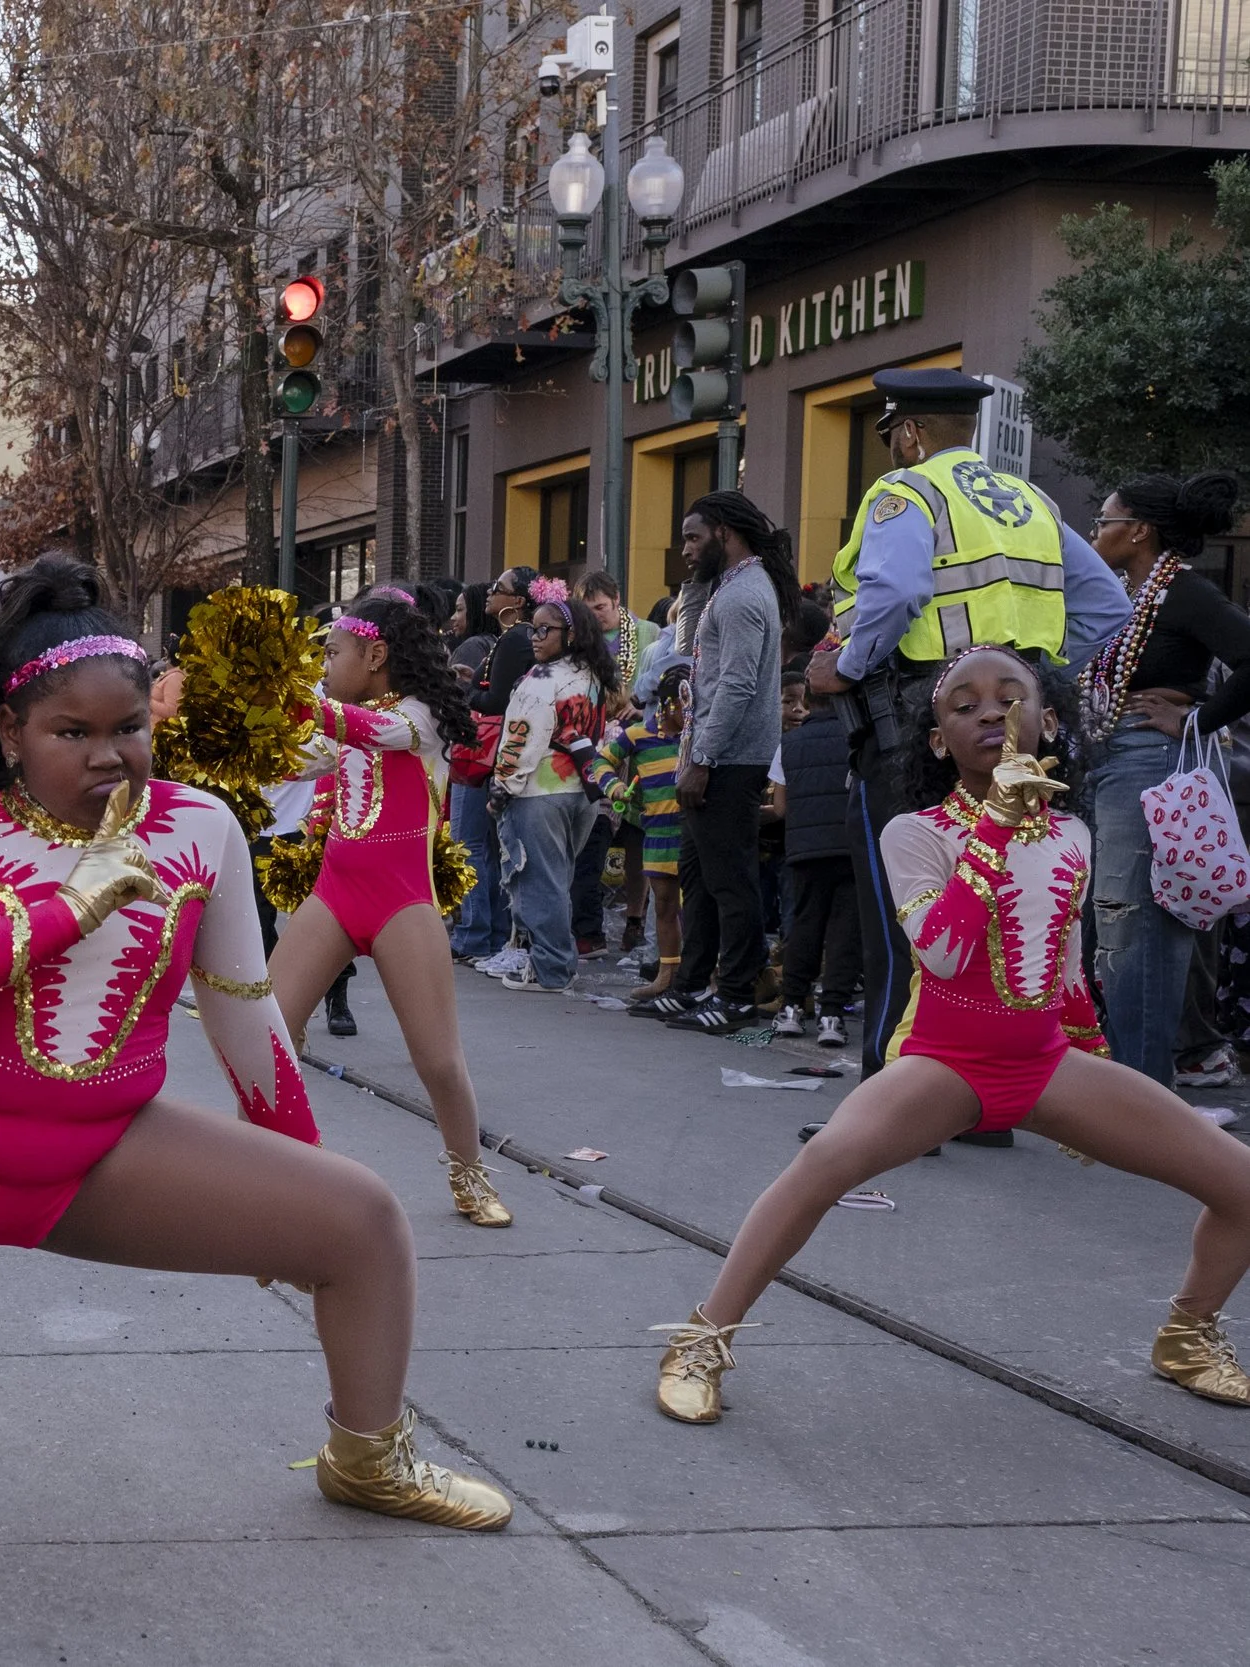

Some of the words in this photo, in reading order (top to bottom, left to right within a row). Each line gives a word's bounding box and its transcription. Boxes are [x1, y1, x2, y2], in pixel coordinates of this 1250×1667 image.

[633, 346, 683, 404] TRU
[778, 260, 911, 357] KITCHEN
[996, 421, 1024, 457] FOOD
